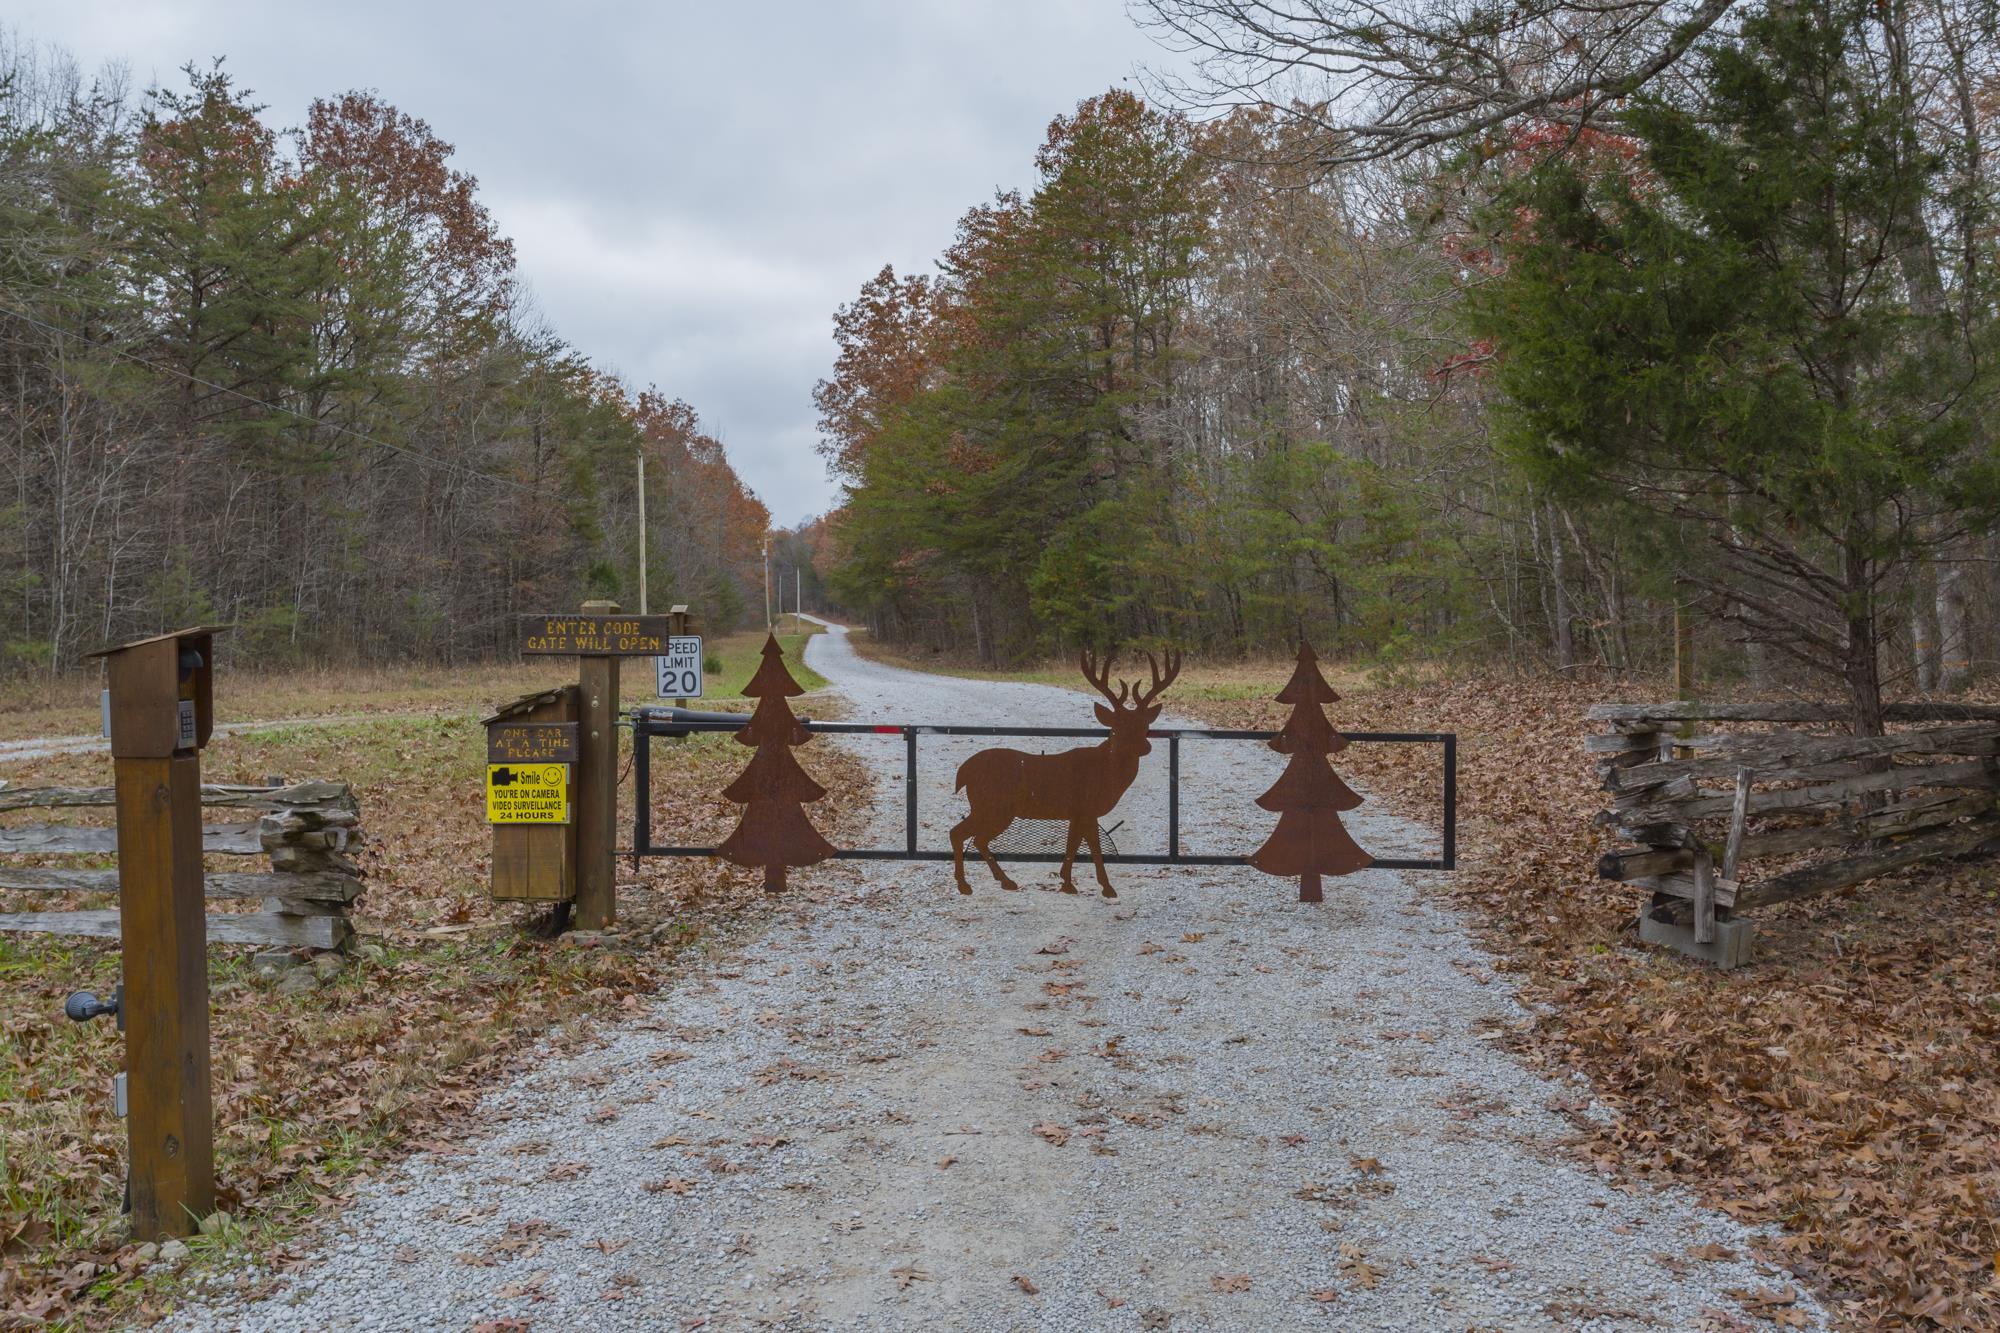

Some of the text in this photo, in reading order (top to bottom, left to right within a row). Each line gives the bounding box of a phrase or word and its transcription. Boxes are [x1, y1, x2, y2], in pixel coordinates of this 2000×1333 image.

[547, 622, 641, 635] ENTER CODE
[528, 636, 660, 650] GATE WILL OPEN
[669, 642, 698, 654] PEED
[663, 657, 694, 669] LIMIT
[662, 671, 697, 693] 20
[503, 728, 528, 738] ONE
[495, 738, 570, 748] AT A TIME
[507, 748, 556, 758] PLEASE
[520, 771, 541, 785] Smile
[493, 789, 560, 799] YOU'RE ON CAMERA
[492, 801, 562, 810] VIDEO SURVEILLANCE
[500, 812, 554, 820] 24 HOURS
